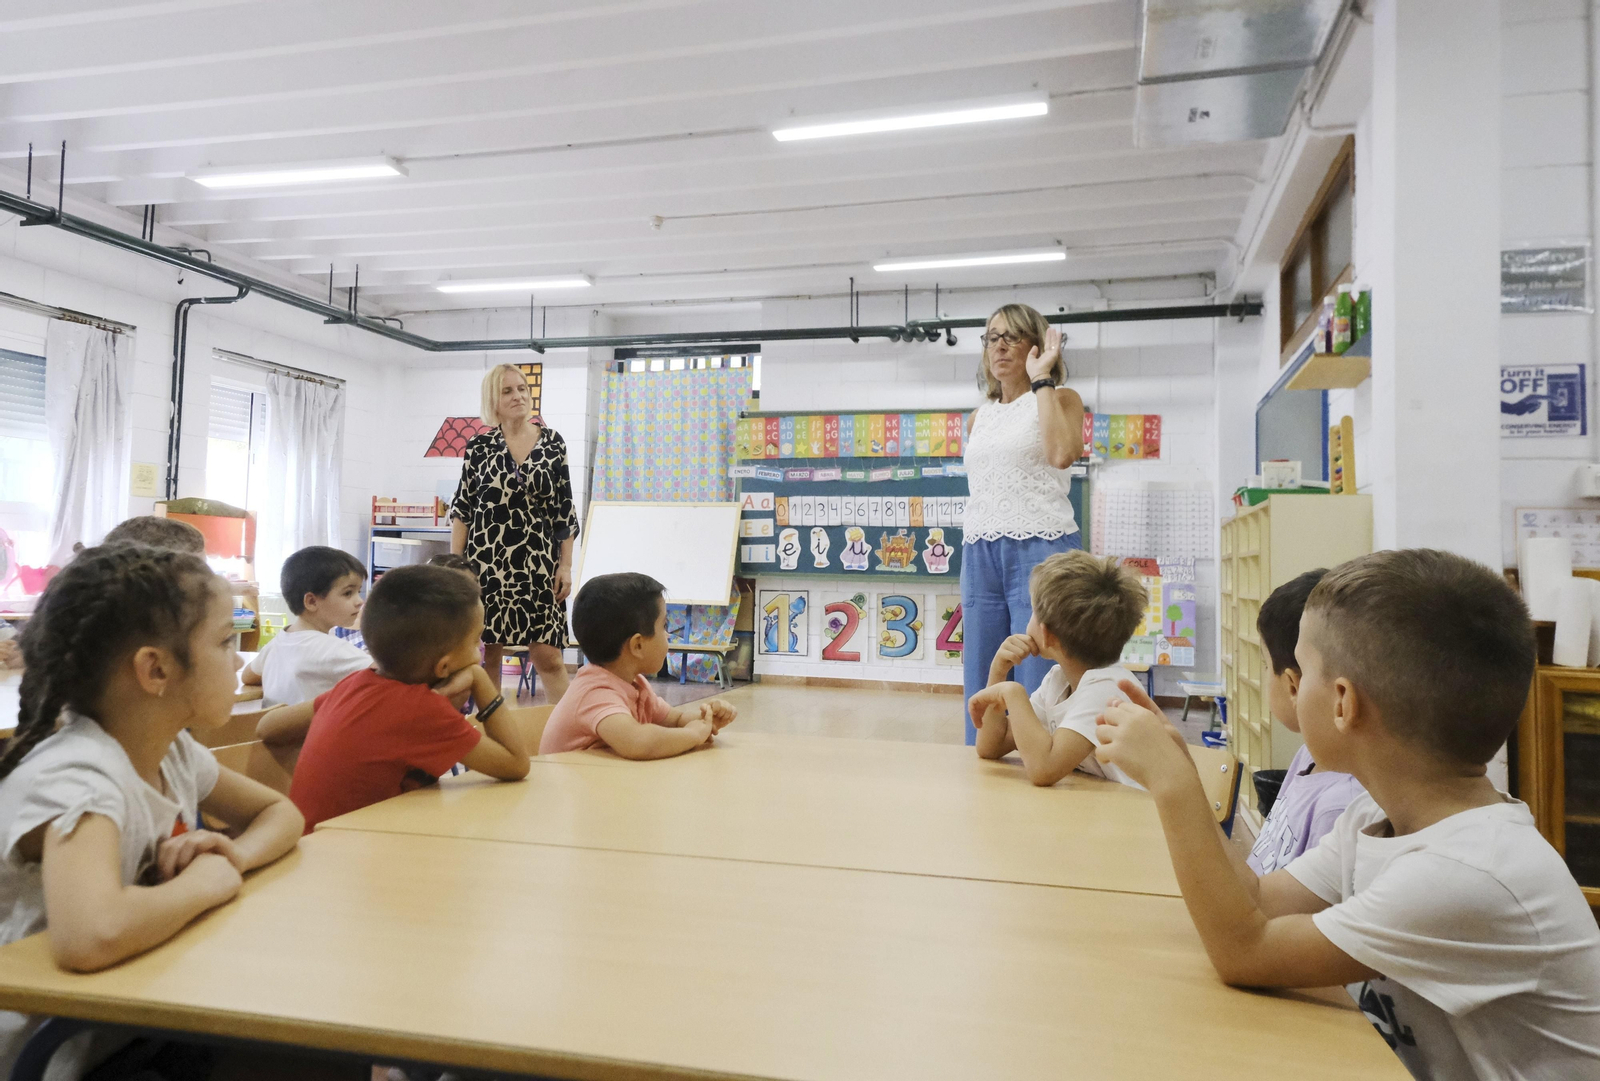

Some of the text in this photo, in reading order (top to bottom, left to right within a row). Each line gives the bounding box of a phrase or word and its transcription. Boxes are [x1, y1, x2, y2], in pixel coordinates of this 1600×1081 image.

[1500, 378, 1544, 393] OFF
[742, 495, 770, 509] A a
[777, 501, 964, 517] 0 1 2 3 4 5 6 7 8 9 10 11 12 13
[744, 522, 769, 536] E e
[782, 538, 949, 557] e i u a
[764, 594, 963, 664] 1 2 3 4
